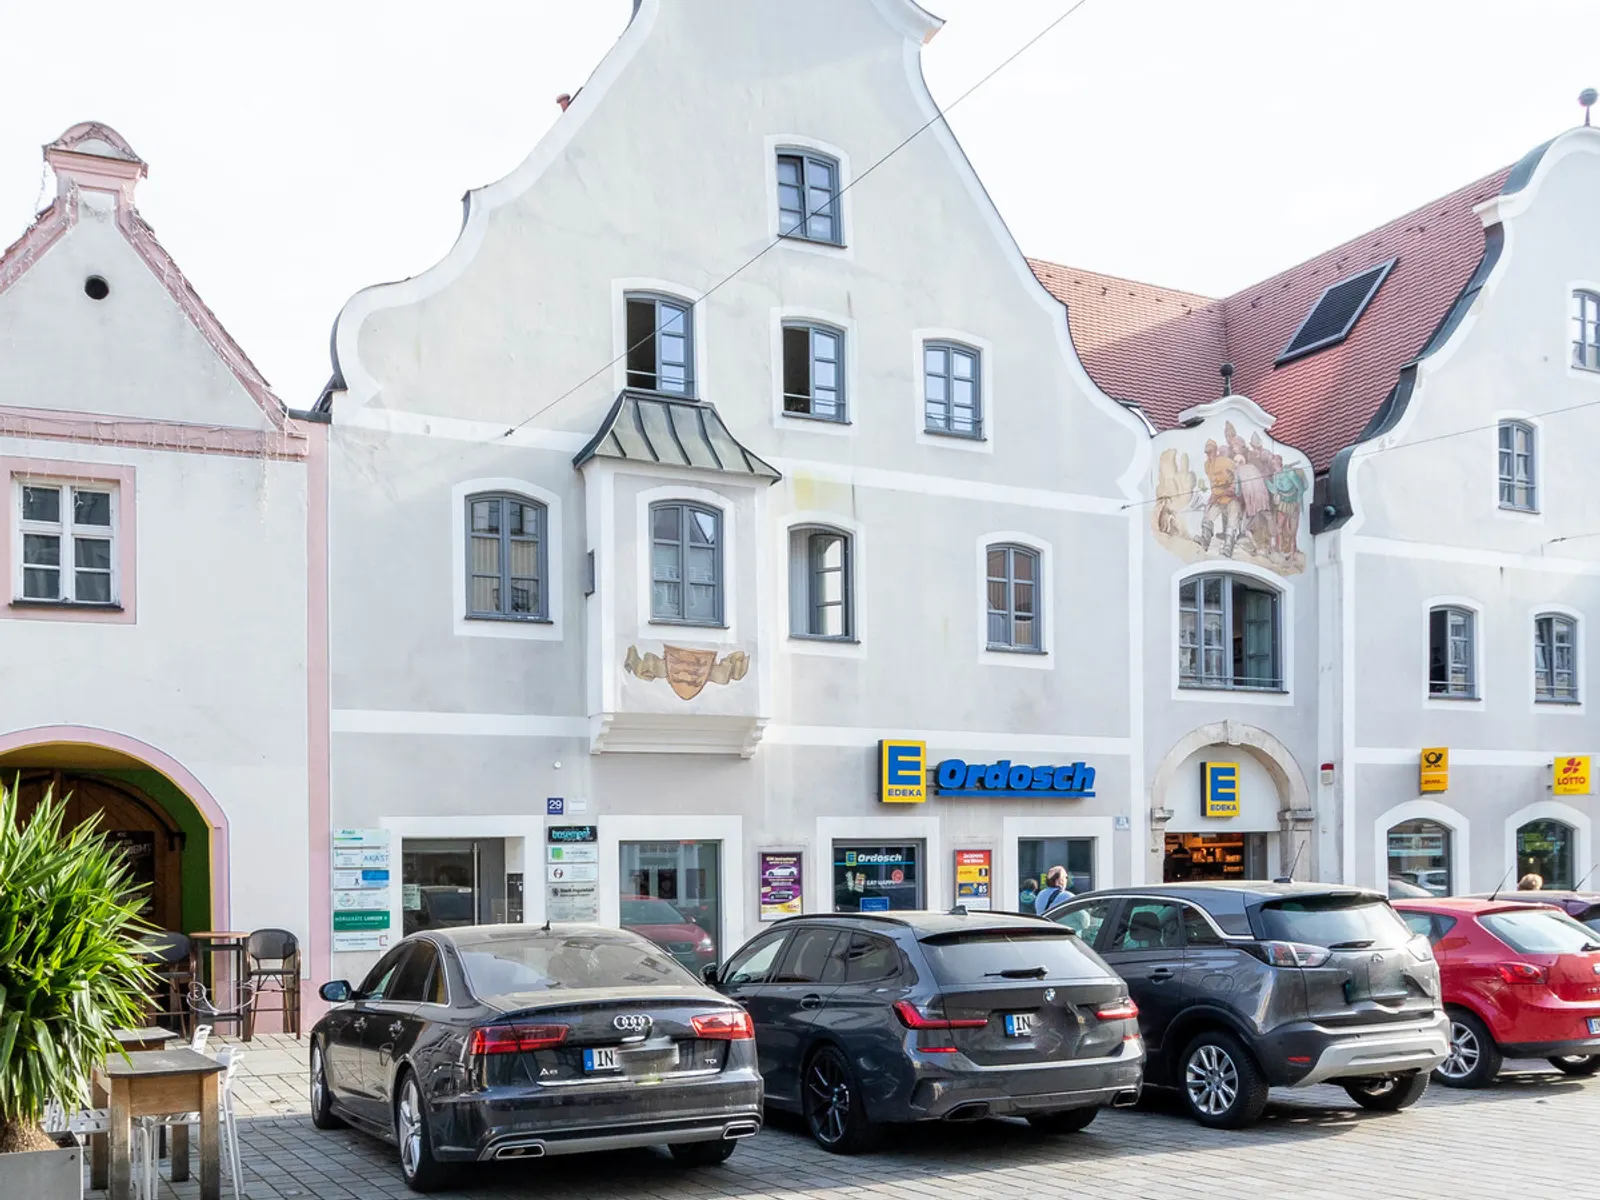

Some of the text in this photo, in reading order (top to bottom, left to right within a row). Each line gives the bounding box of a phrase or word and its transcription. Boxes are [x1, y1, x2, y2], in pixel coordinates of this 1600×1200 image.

[888, 745, 922, 786] E
[936, 758, 1096, 791] Ordosch
[1210, 767, 1236, 802] E
[1557, 776, 1586, 786] LOTTO
[887, 788, 923, 797] EDEKA
[549, 799, 562, 810] 29
[1210, 803, 1237, 811] EDEKA
[857, 853, 902, 863] Ordosch
[597, 1049, 614, 1067] IN
